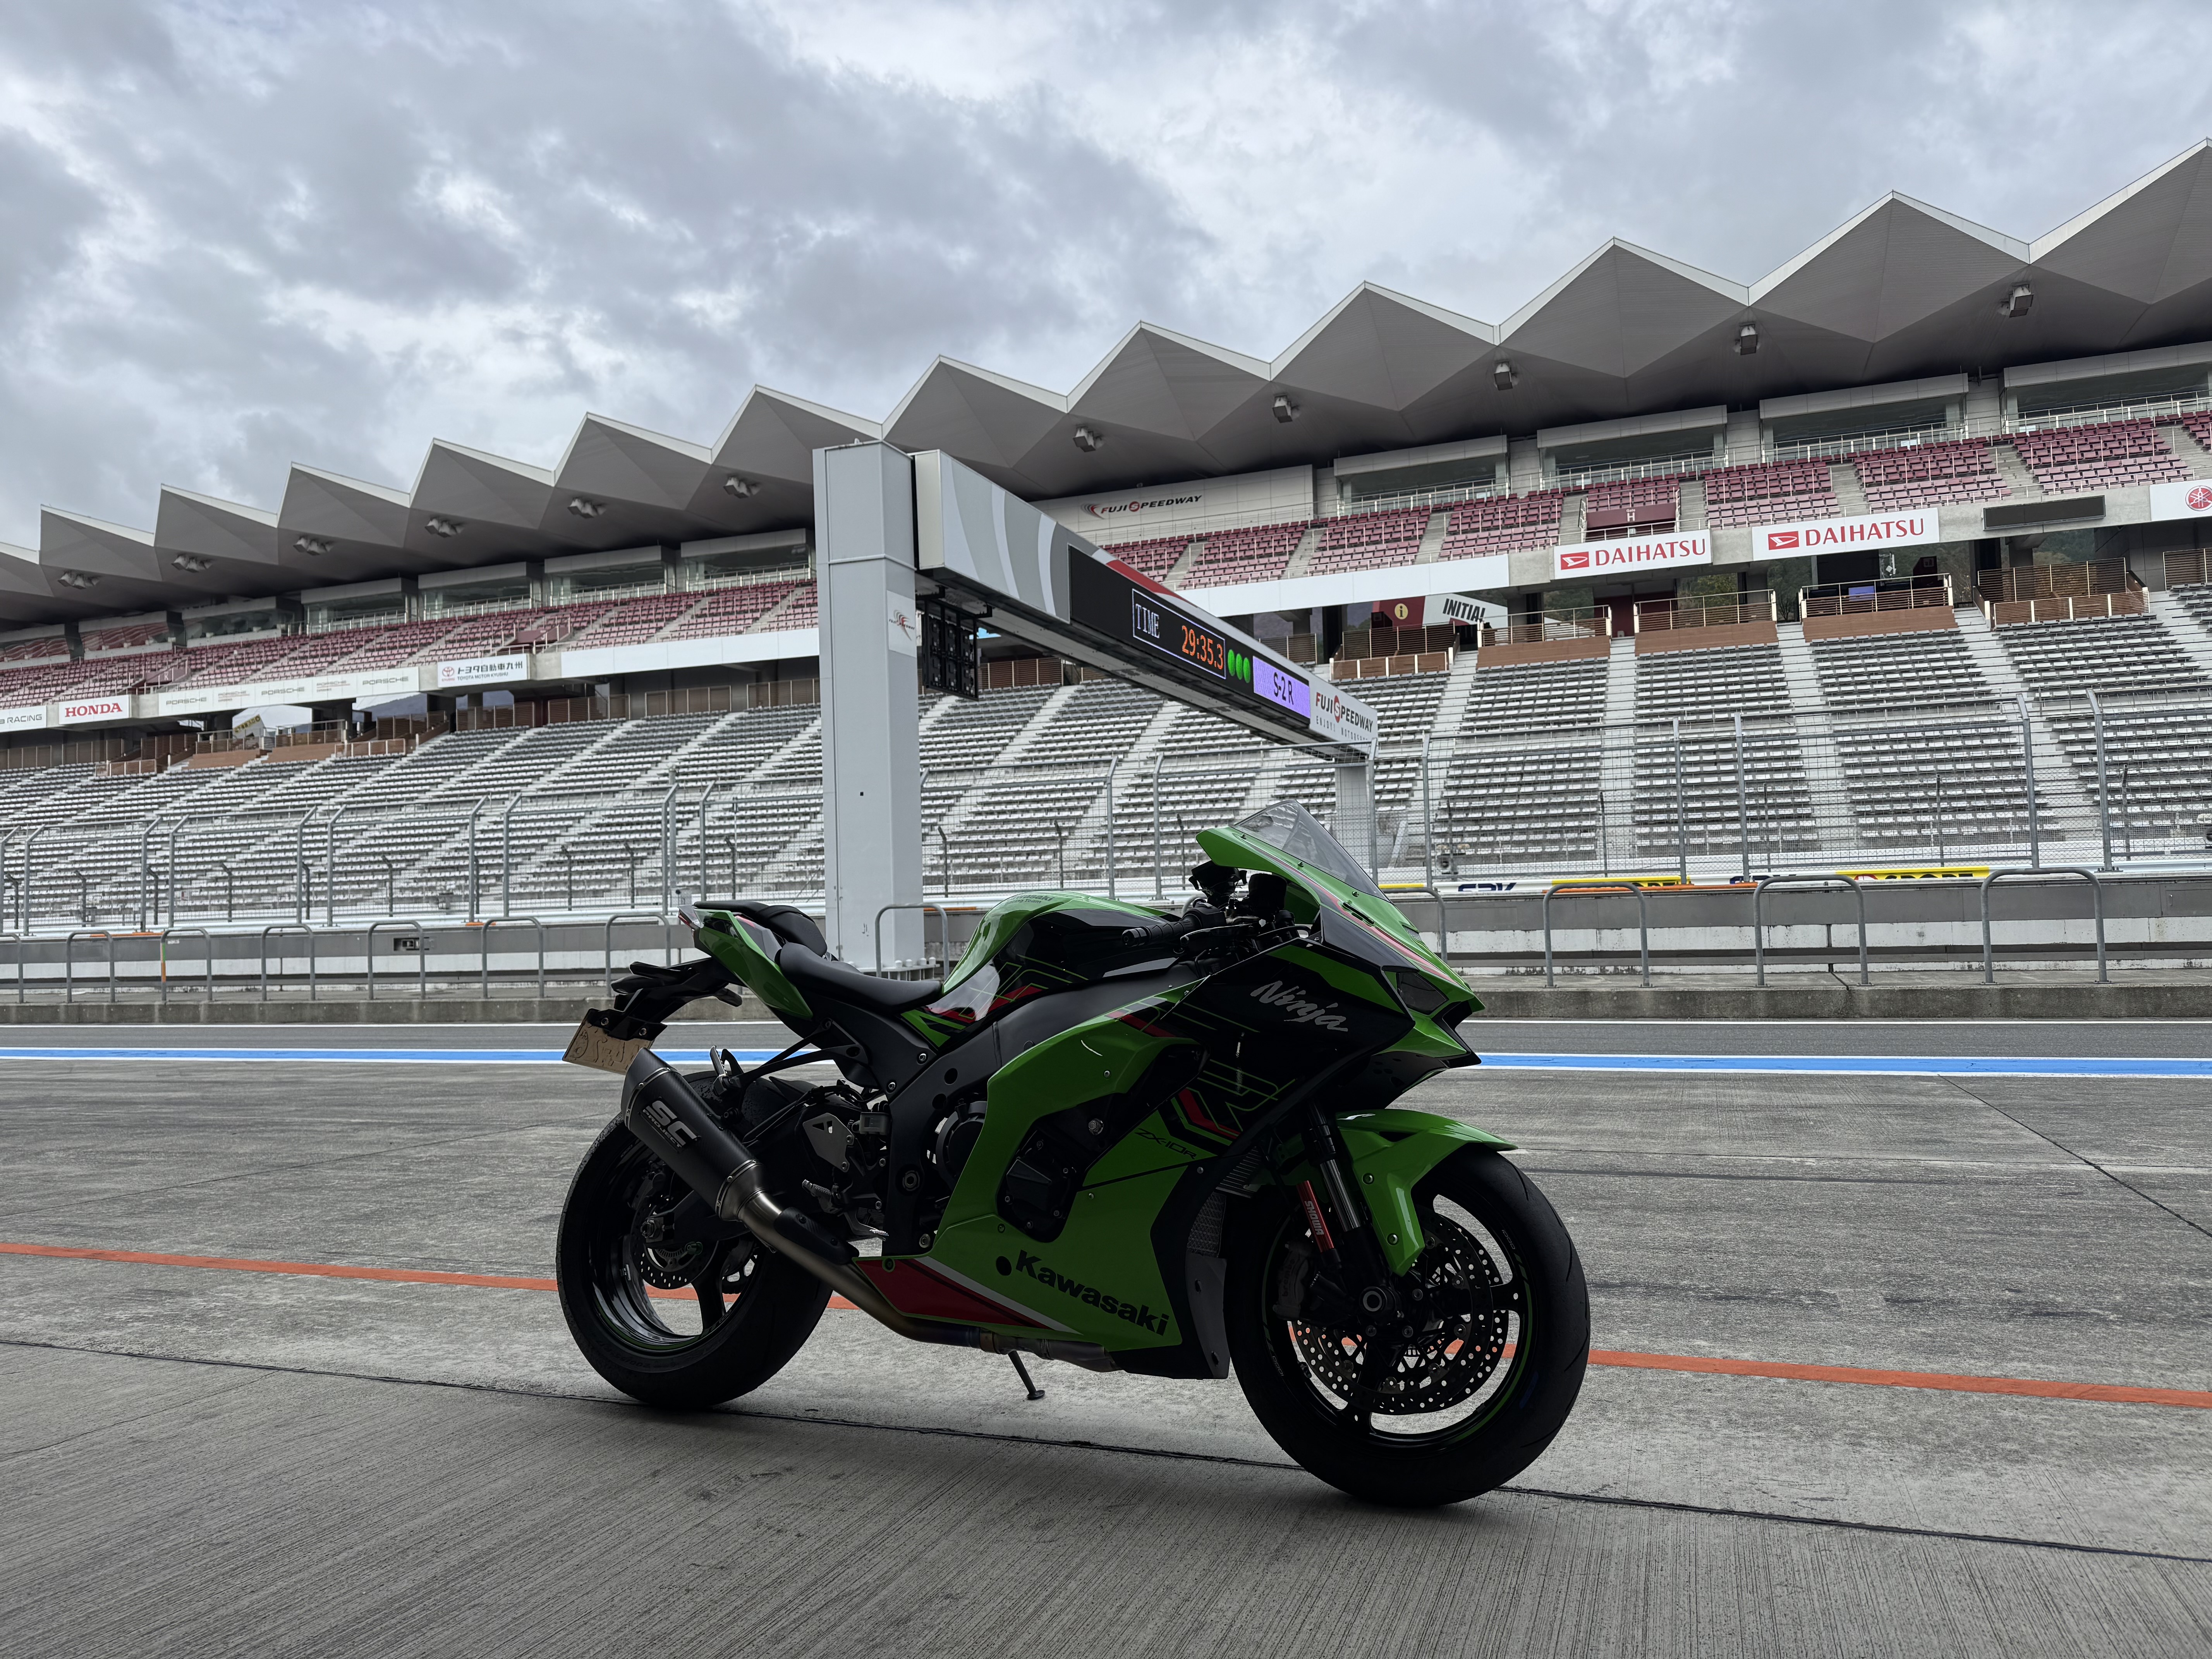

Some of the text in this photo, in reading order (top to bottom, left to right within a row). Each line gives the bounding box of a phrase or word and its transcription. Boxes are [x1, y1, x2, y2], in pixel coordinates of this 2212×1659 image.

[1101, 495, 1202, 514] FUJI SPEEDWAY
[1627, 512, 1635, 522] H
[1806, 519, 1924, 546] DAIHATSU
[1595, 539, 1706, 566] DAIHATSU
[1135, 603, 1160, 639] TIME
[1182, 625, 1223, 670] 29:35.3
[362, 676, 408, 685] PORSCHE
[458, 661, 522, 674] トヨタ自動車九州
[166, 697, 207, 705] PORSCHE
[261, 687, 305, 696] PORSCHE
[7, 714, 42, 723] RACING
[65, 702, 122, 717] HONDA
[1316, 692, 1373, 733] FUJI SPEEDWAY
[1250, 980, 1348, 1032] Ninja
[642, 1109, 682, 1147] PROJECT
[646, 1100, 697, 1146] SC
[1134, 1128, 1197, 1159] ZX-10R
[1304, 1200, 1324, 1235] SHOWA
[1016, 1250, 1169, 1336] Kawasaki
